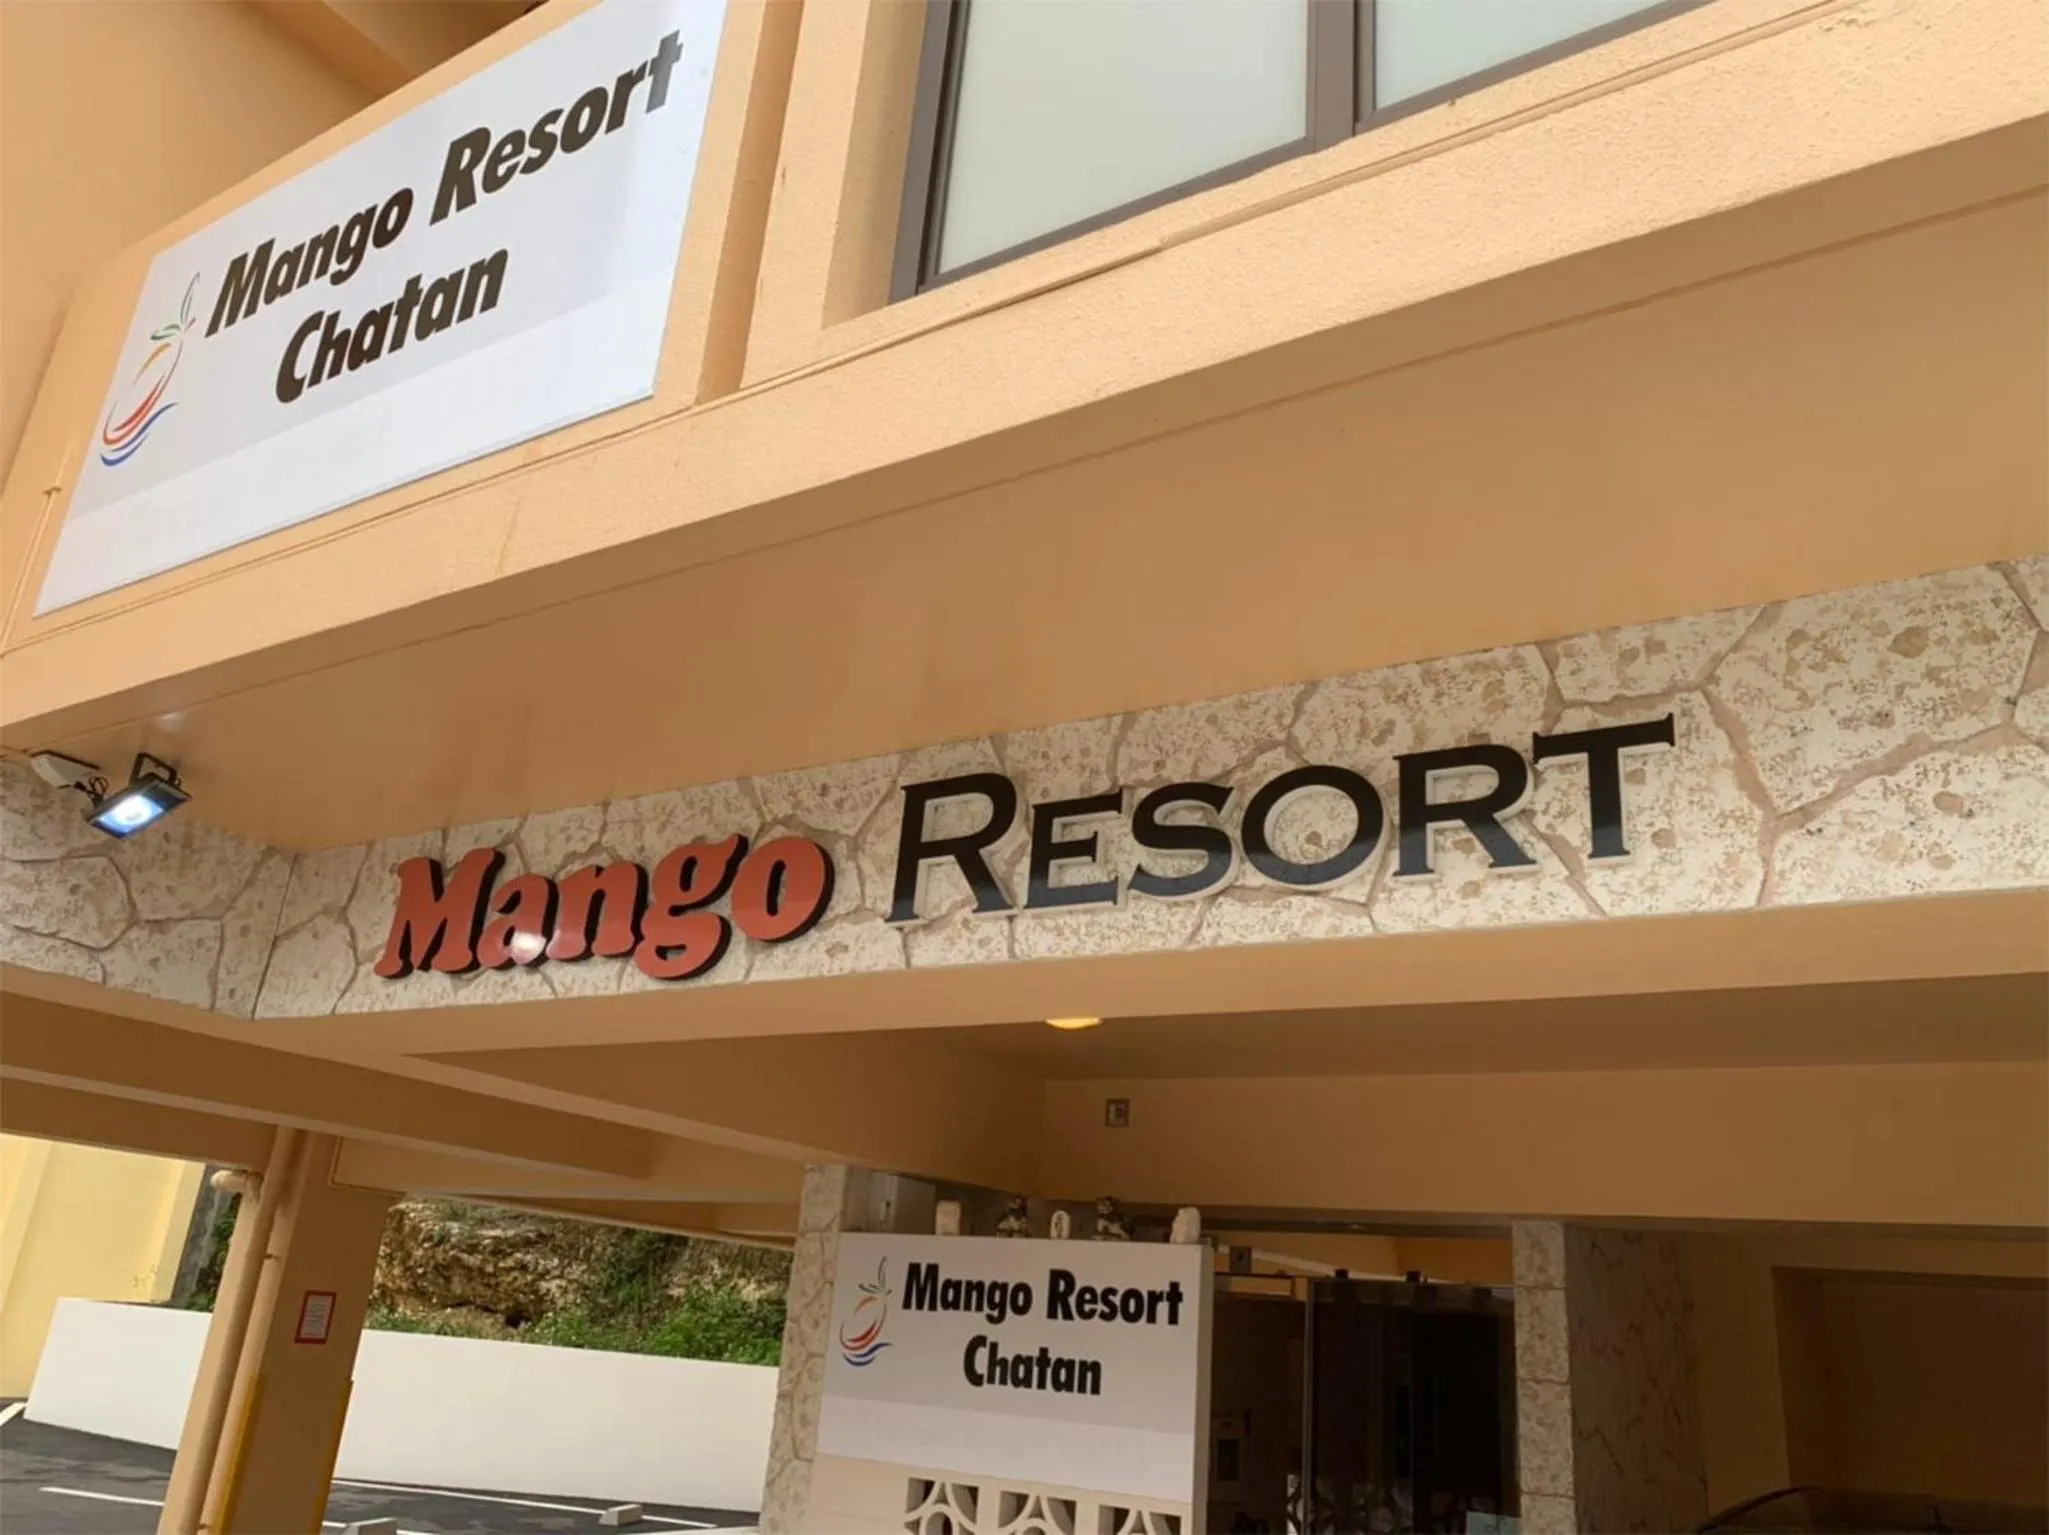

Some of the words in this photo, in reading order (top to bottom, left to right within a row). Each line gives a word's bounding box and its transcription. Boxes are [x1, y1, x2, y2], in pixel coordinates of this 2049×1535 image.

[204, 187, 414, 338] Mango
[429, 29, 684, 226] Resort
[275, 248, 509, 404] Chatan
[374, 834, 833, 979] Mango
[885, 712, 1675, 923] RESORT
[902, 1262, 1033, 1325] Mango
[1046, 1268, 1184, 1326] Resort
[963, 1335, 1102, 1396] Chatan
